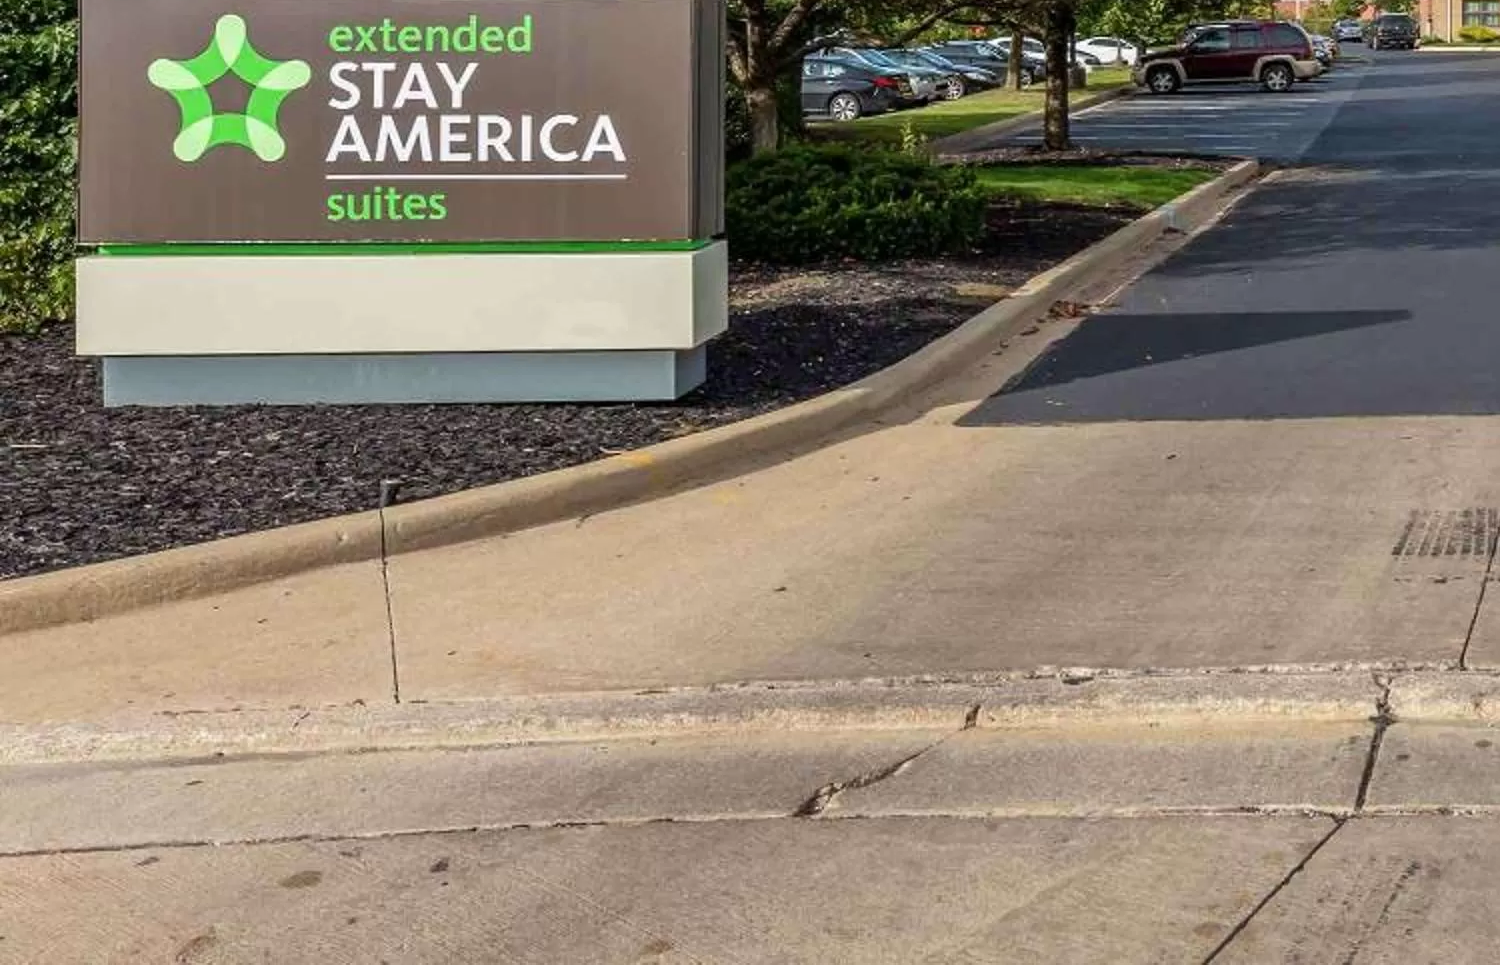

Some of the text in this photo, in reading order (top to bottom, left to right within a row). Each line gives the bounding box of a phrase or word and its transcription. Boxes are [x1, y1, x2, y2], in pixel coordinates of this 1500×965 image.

[328, 14, 533, 53] extended
[328, 61, 480, 110] STAY
[325, 114, 627, 163] AMERICA
[326, 186, 448, 221] suites
